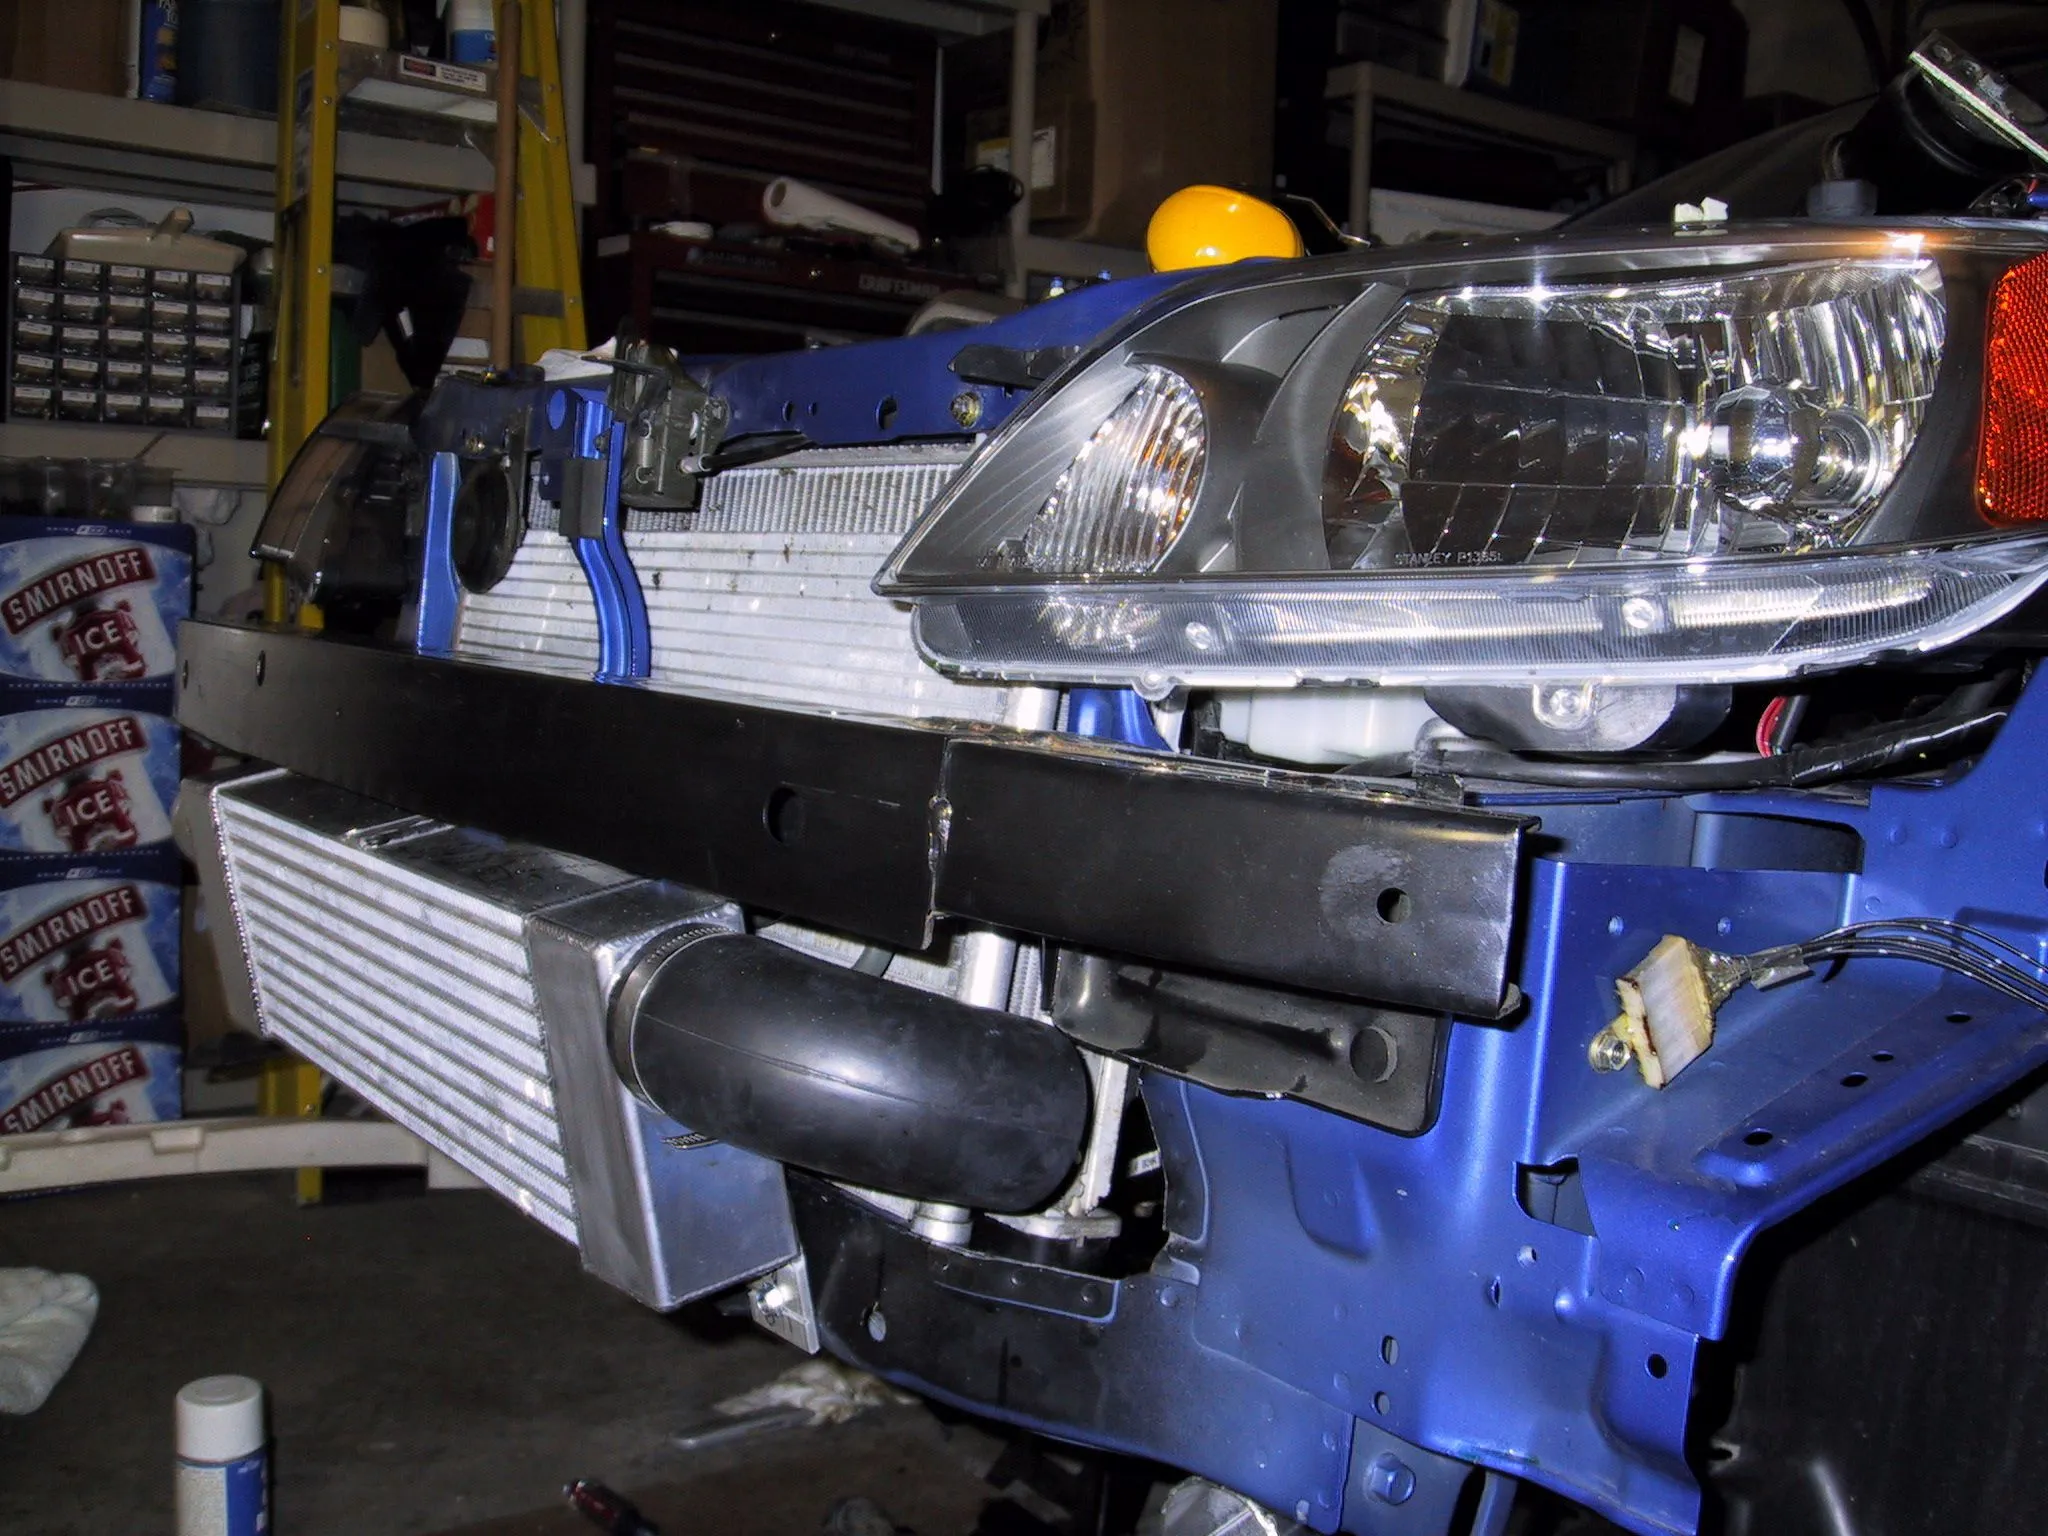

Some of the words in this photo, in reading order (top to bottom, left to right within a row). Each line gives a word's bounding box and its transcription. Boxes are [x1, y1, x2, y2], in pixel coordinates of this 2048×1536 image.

[1395, 551, 1452, 565] STANLEY
[8, 551, 142, 626] SMIRNOFF
[74, 620, 122, 654] ICE
[0, 720, 133, 800] SMIRNOFF
[66, 790, 114, 826] ICE
[1, 889, 133, 973] SMIRNOFF
[68, 959, 115, 996] ICE
[4, 1051, 136, 1134] SMIRNOFF
